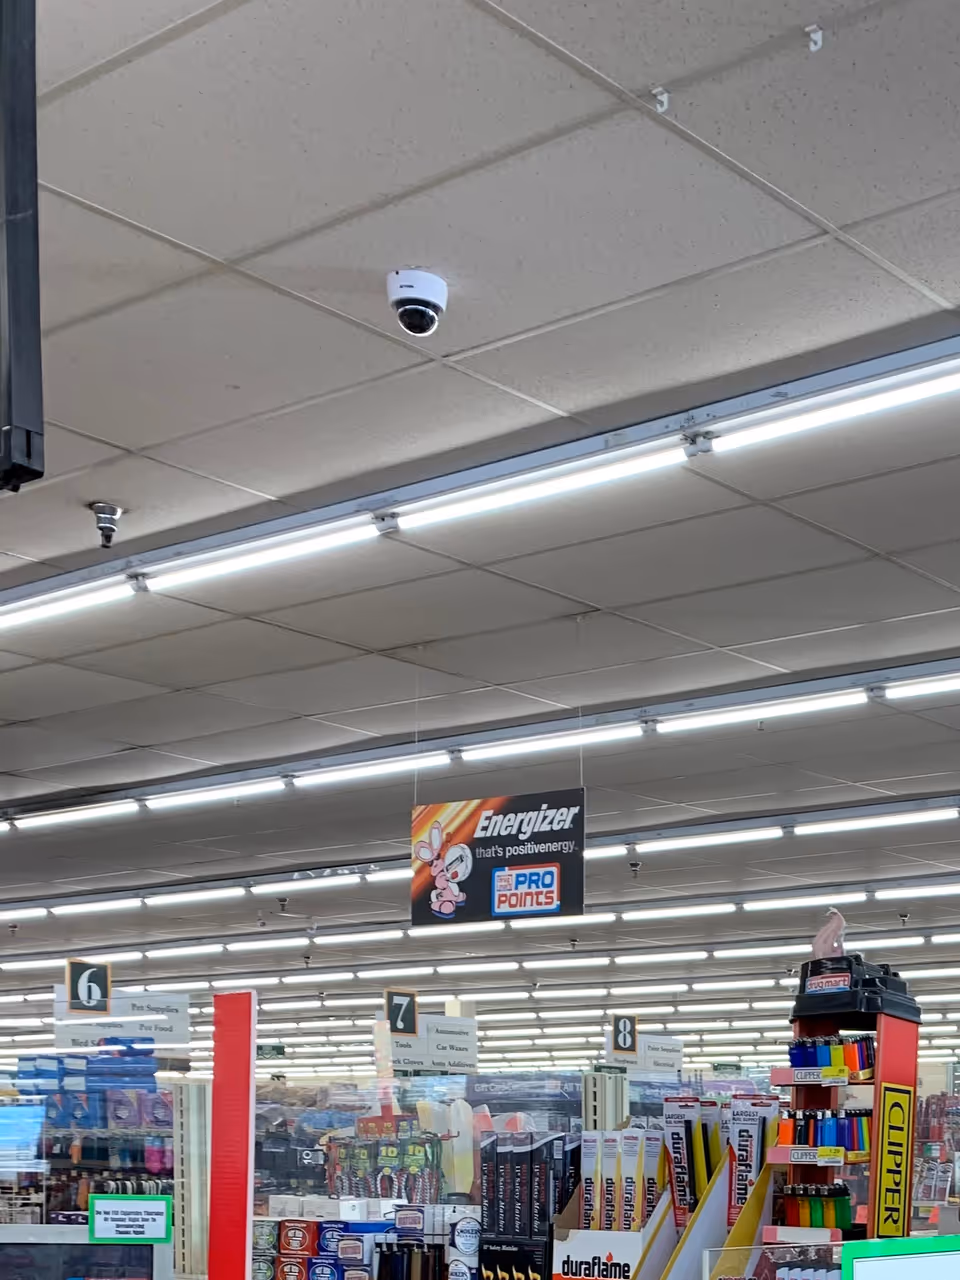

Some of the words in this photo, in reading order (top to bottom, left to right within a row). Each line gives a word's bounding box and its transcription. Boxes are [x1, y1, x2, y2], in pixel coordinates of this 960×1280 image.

[473, 804, 580, 840] Energizer
[476, 845, 503, 858] that's
[515, 870, 555, 890] PRO
[497, 890, 555, 909] POINTS
[77, 968, 101, 1007] 6
[827, 976, 849, 990] mart
[393, 996, 410, 1029] 7
[618, 1018, 632, 1048] 8
[796, 1071, 821, 1080] CLIPPER
[732, 1110, 758, 1118] LARGEST
[381, 1147, 397, 1157] 10
[408, 1145, 424, 1155] 10
[792, 1151, 817, 1161] CLIPPER
[883, 1101, 905, 1226] CLIPPER
[671, 1131, 688, 1207] duraflame
[737, 1129, 753, 1205] duraflame
[583, 1177, 594, 1230] duraflam
[604, 1177, 615, 1230] duraflam
[623, 1177, 635, 1230] duraflam
[562, 1255, 631, 1279] duraflame
